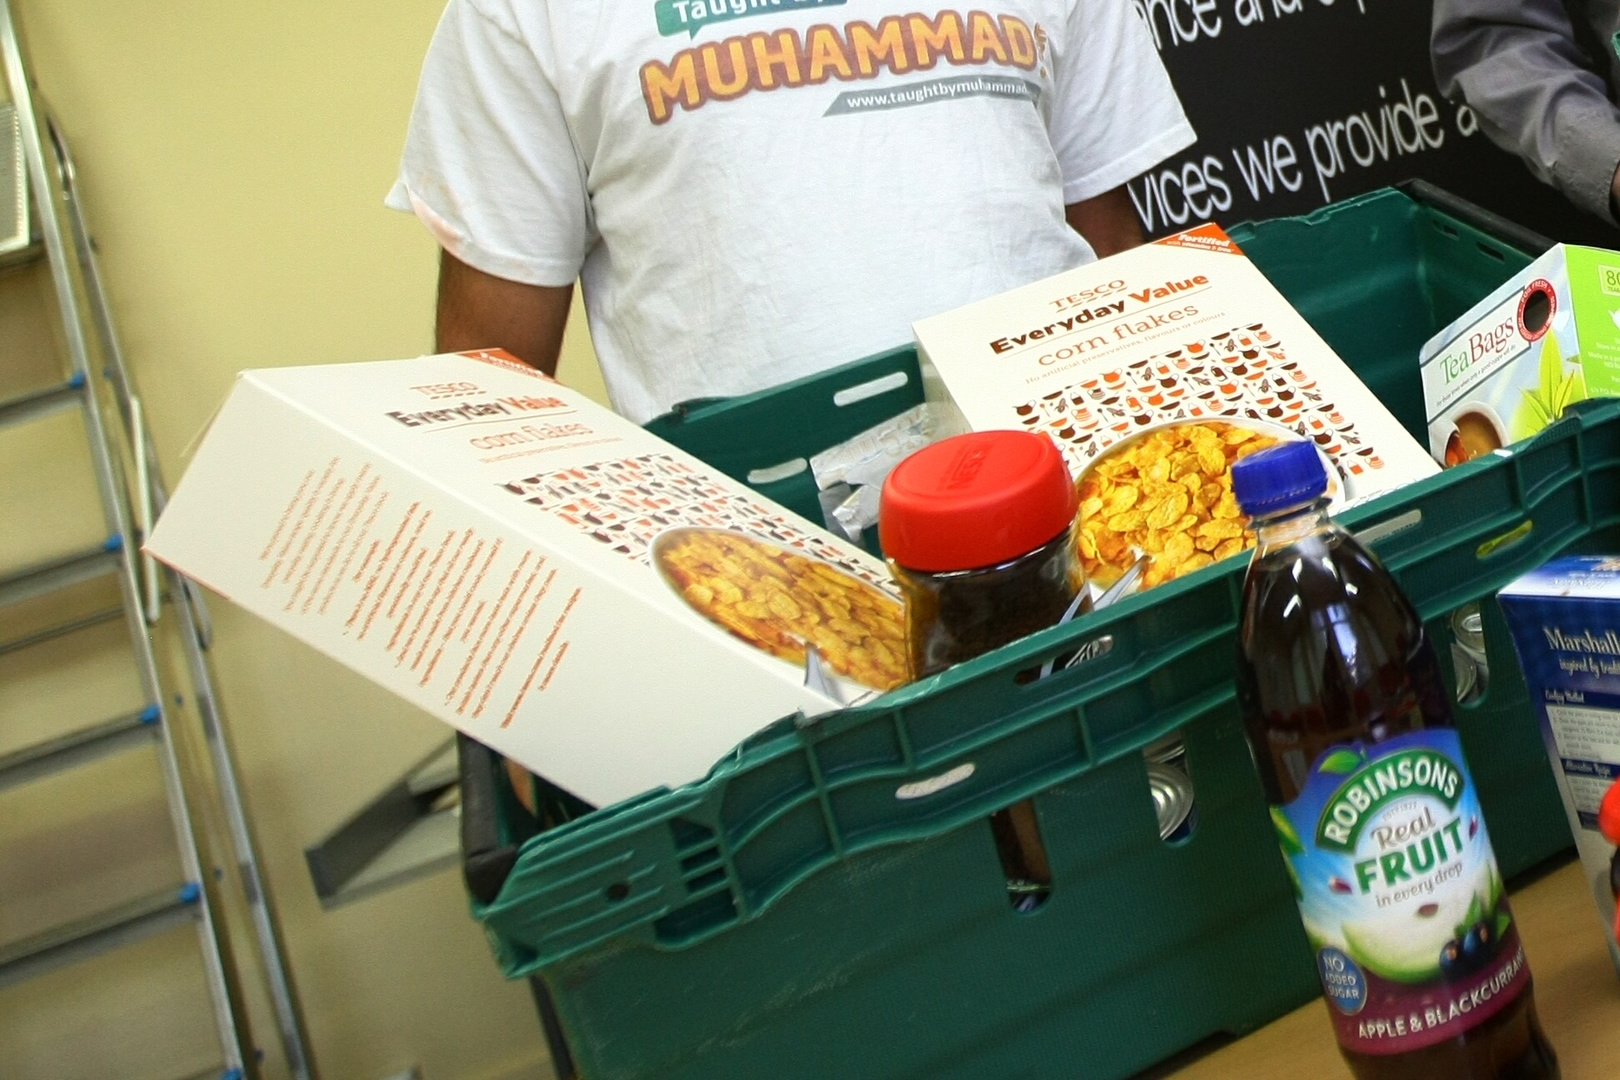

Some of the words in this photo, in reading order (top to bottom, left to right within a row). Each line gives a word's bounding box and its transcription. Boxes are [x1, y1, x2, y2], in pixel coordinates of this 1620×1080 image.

[641, 9, 1036, 123] MUHAMMAD
[1232, 133, 1302, 201] we
[1305, 77, 1444, 204] provide
[1049, 279, 1126, 309] TESCO
[989, 300, 1126, 355] Everyday
[1128, 275, 1210, 304] Value
[1038, 336, 1109, 367] corn
[1112, 305, 1199, 341] flakes
[410, 381, 481, 396] TESCO
[1041, 360, 1081, 381] artificial
[385, 402, 511, 428] Everyday
[500, 395, 569, 412] Value
[1323, 754, 1459, 846] ROBINSONS
[1371, 806, 1436, 851] Real
[1354, 816, 1465, 896] FRUIT
[1375, 894, 1392, 909] in
[1392, 877, 1436, 904] every
[1434, 860, 1465, 886] drop
[1322, 955, 1346, 973] NO
[1324, 972, 1357, 988] ADDED
[1327, 983, 1361, 1001] SUGAR
[1358, 1014, 1407, 1040] APPLE
[1409, 1012, 1424, 1033] &
